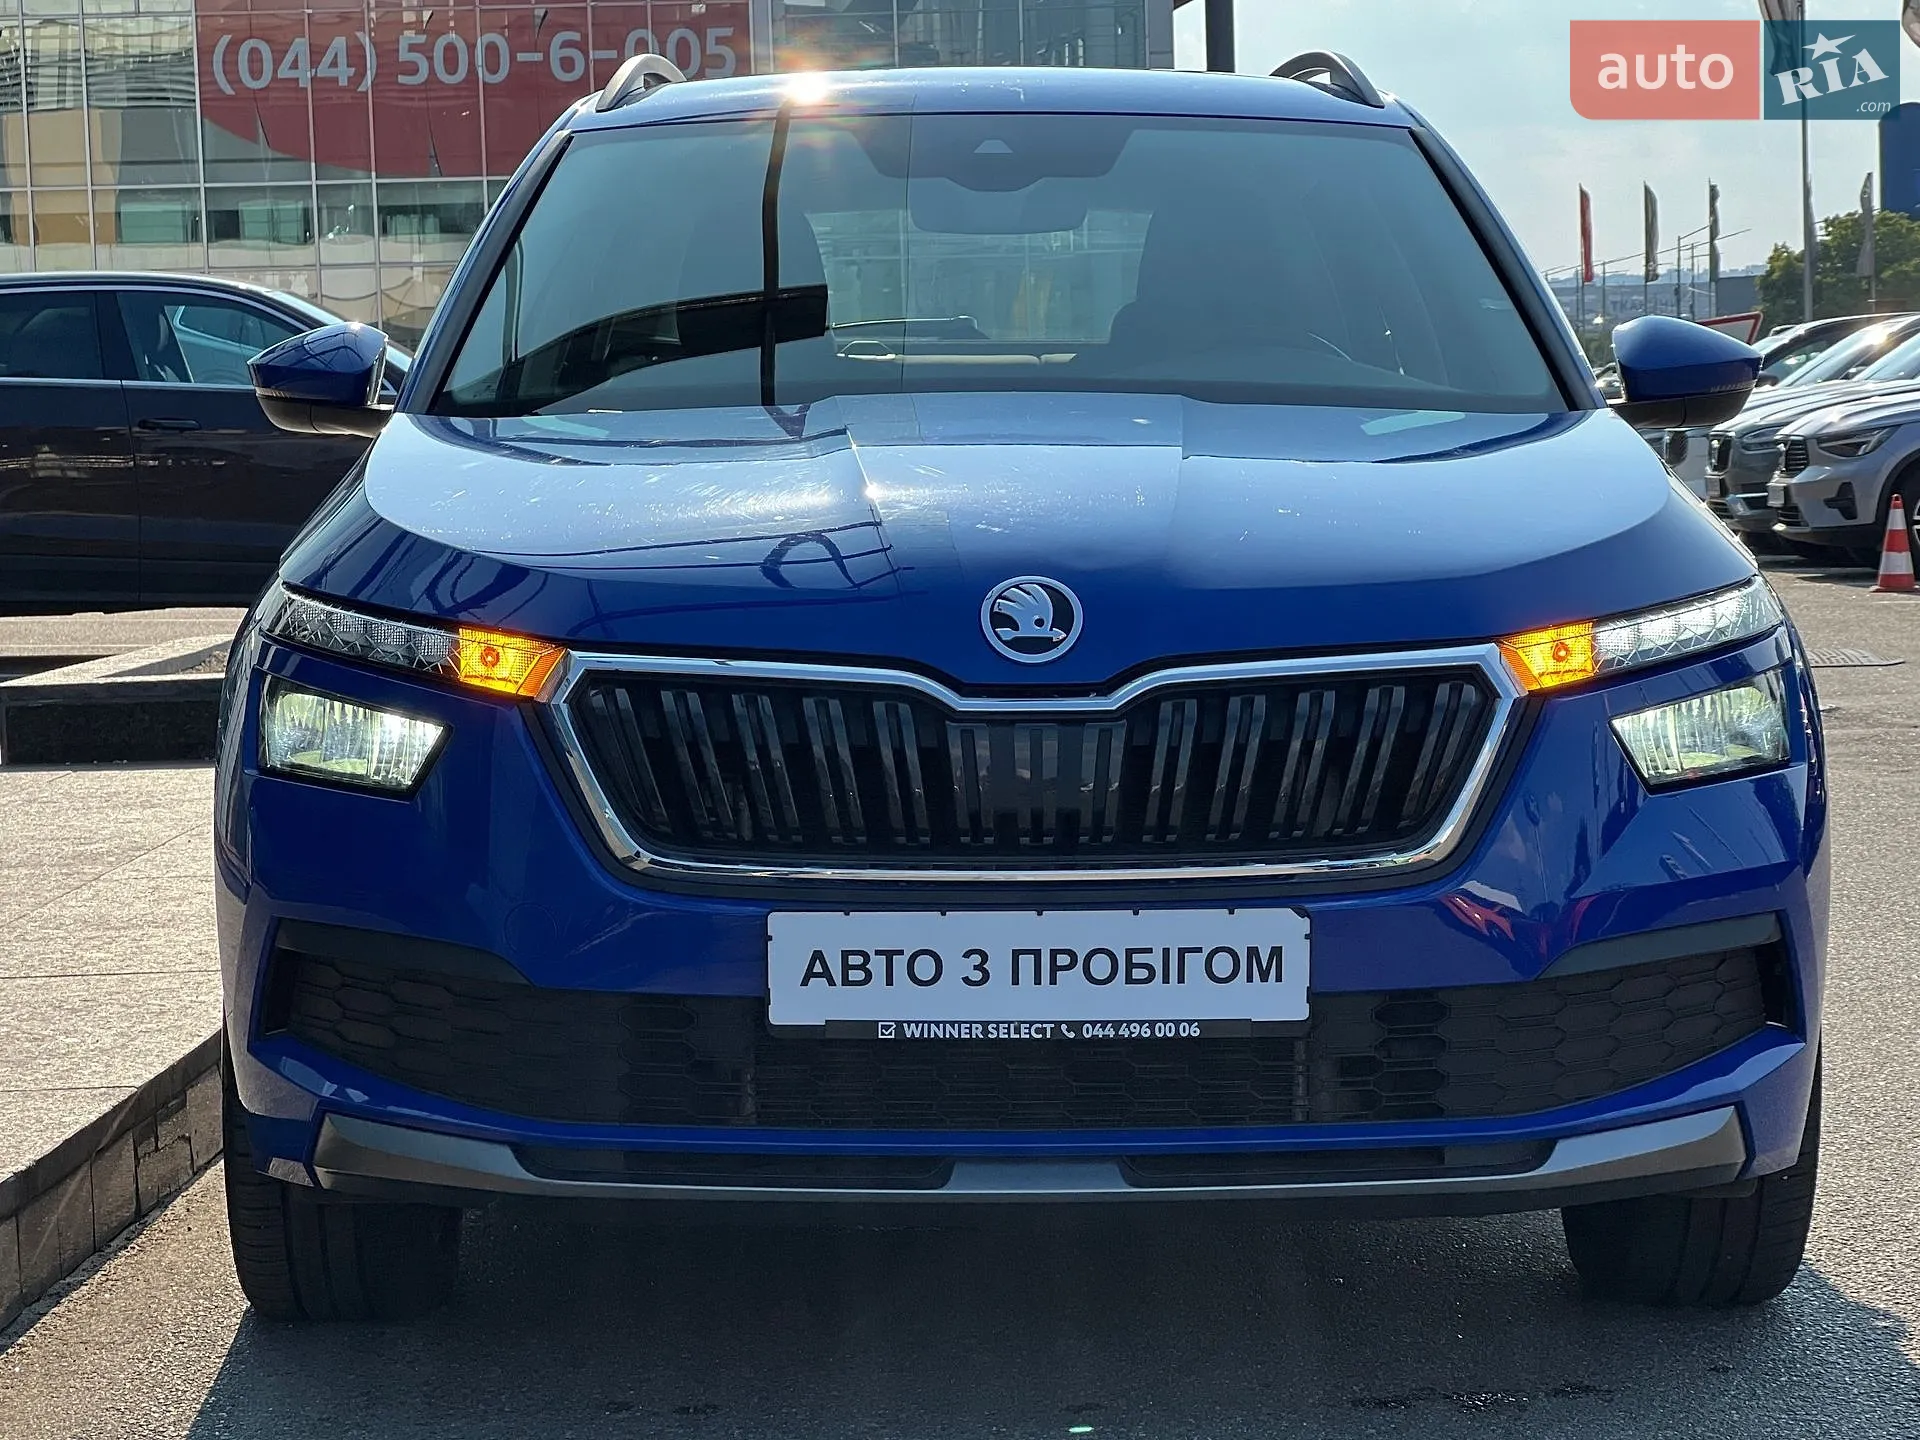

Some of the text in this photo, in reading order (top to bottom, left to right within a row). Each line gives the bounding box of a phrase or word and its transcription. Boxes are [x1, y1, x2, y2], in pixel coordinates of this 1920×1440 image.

[213, 27, 737, 95] (044) 500-6-005
[800, 945, 1284, 988] АВТО З ПРОБІГОМ
[902, 1020, 1201, 1039] WINNER SELECT 044 496 00 06
